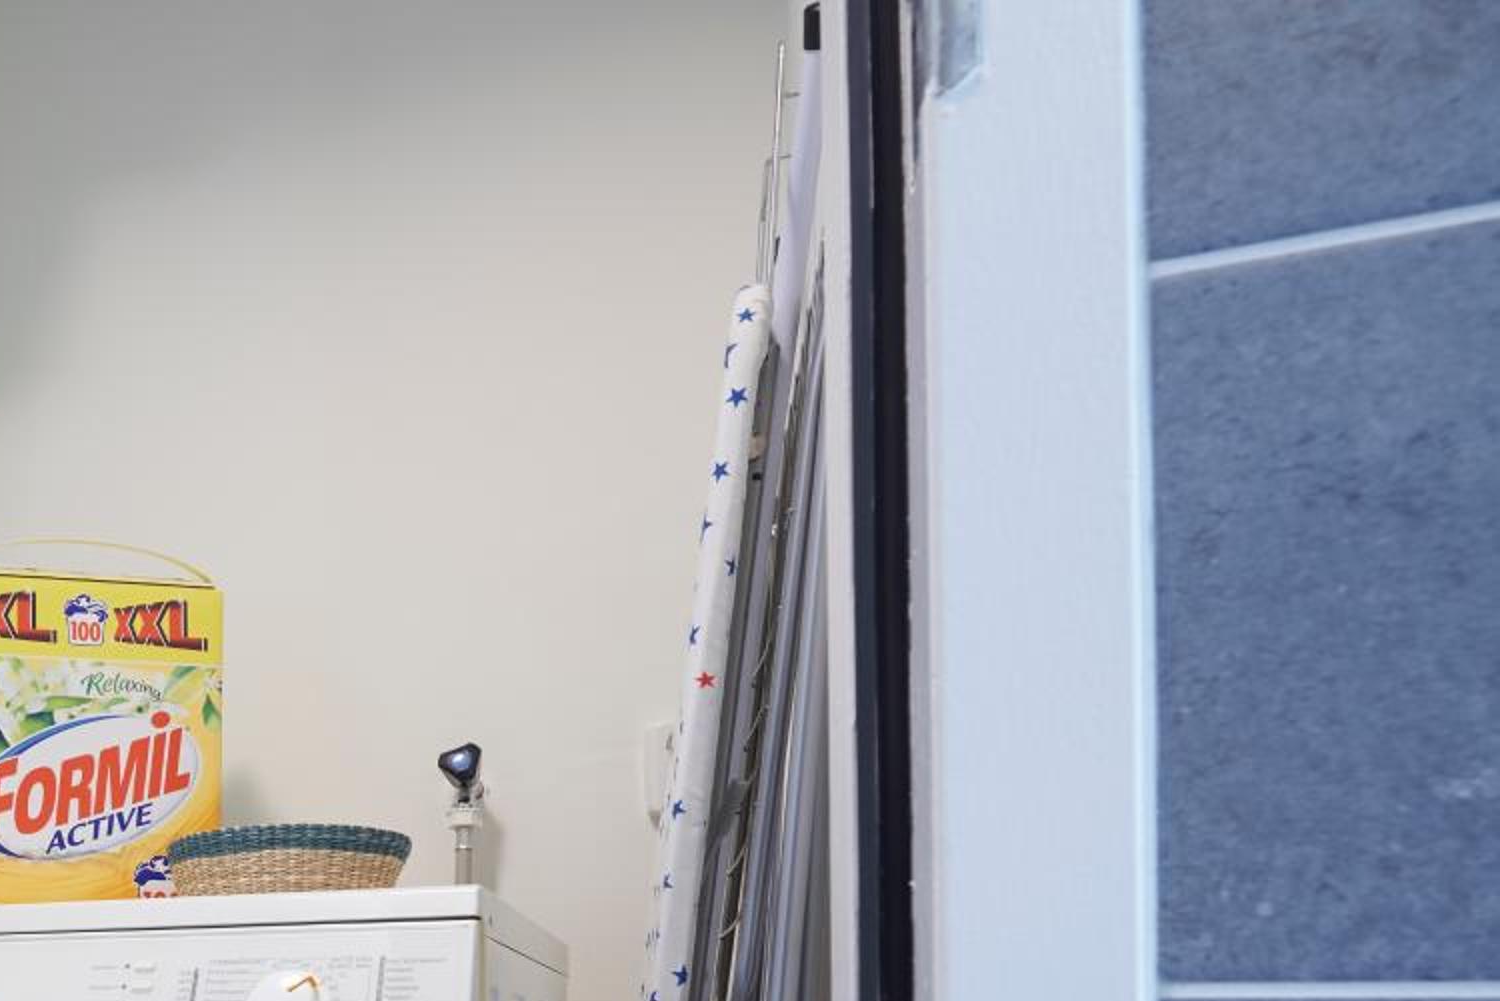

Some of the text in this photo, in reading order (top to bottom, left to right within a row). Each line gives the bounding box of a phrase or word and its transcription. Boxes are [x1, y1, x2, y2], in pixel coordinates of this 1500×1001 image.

[71, 621, 101, 641] 100
[114, 600, 208, 651] XXL
[80, 671, 163, 702] Relaxing
[46, 803, 153, 854] ACTIVE
